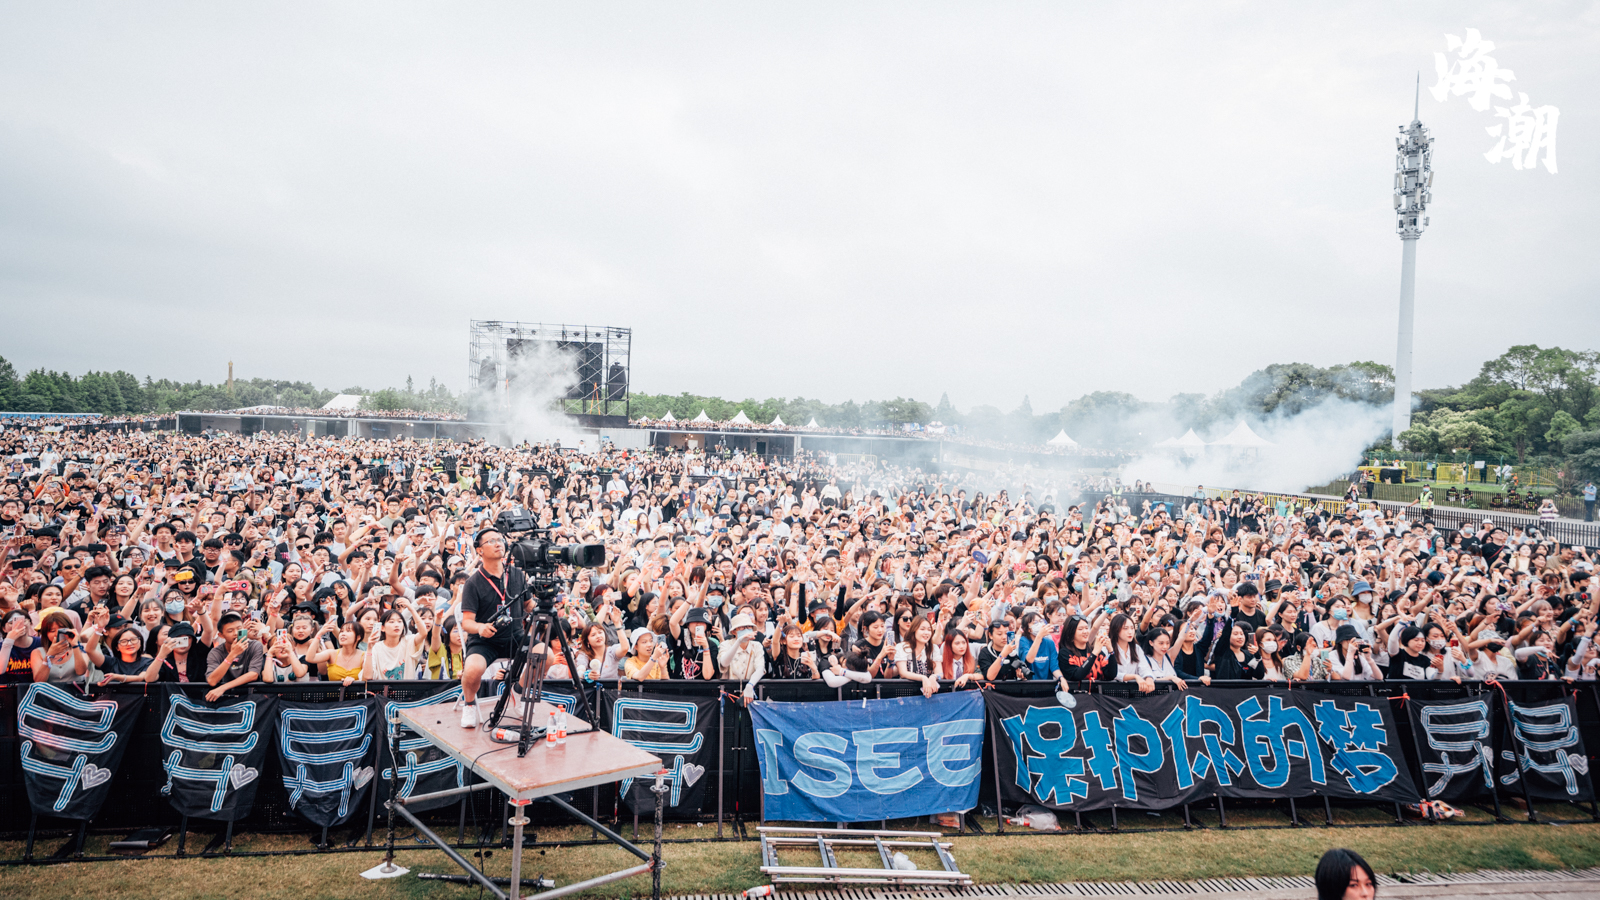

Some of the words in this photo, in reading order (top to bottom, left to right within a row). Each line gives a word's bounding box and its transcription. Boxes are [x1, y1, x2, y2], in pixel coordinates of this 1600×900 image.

[755, 718, 984, 798] ISEE
[1001, 695, 1398, 805] 保护你的梦
